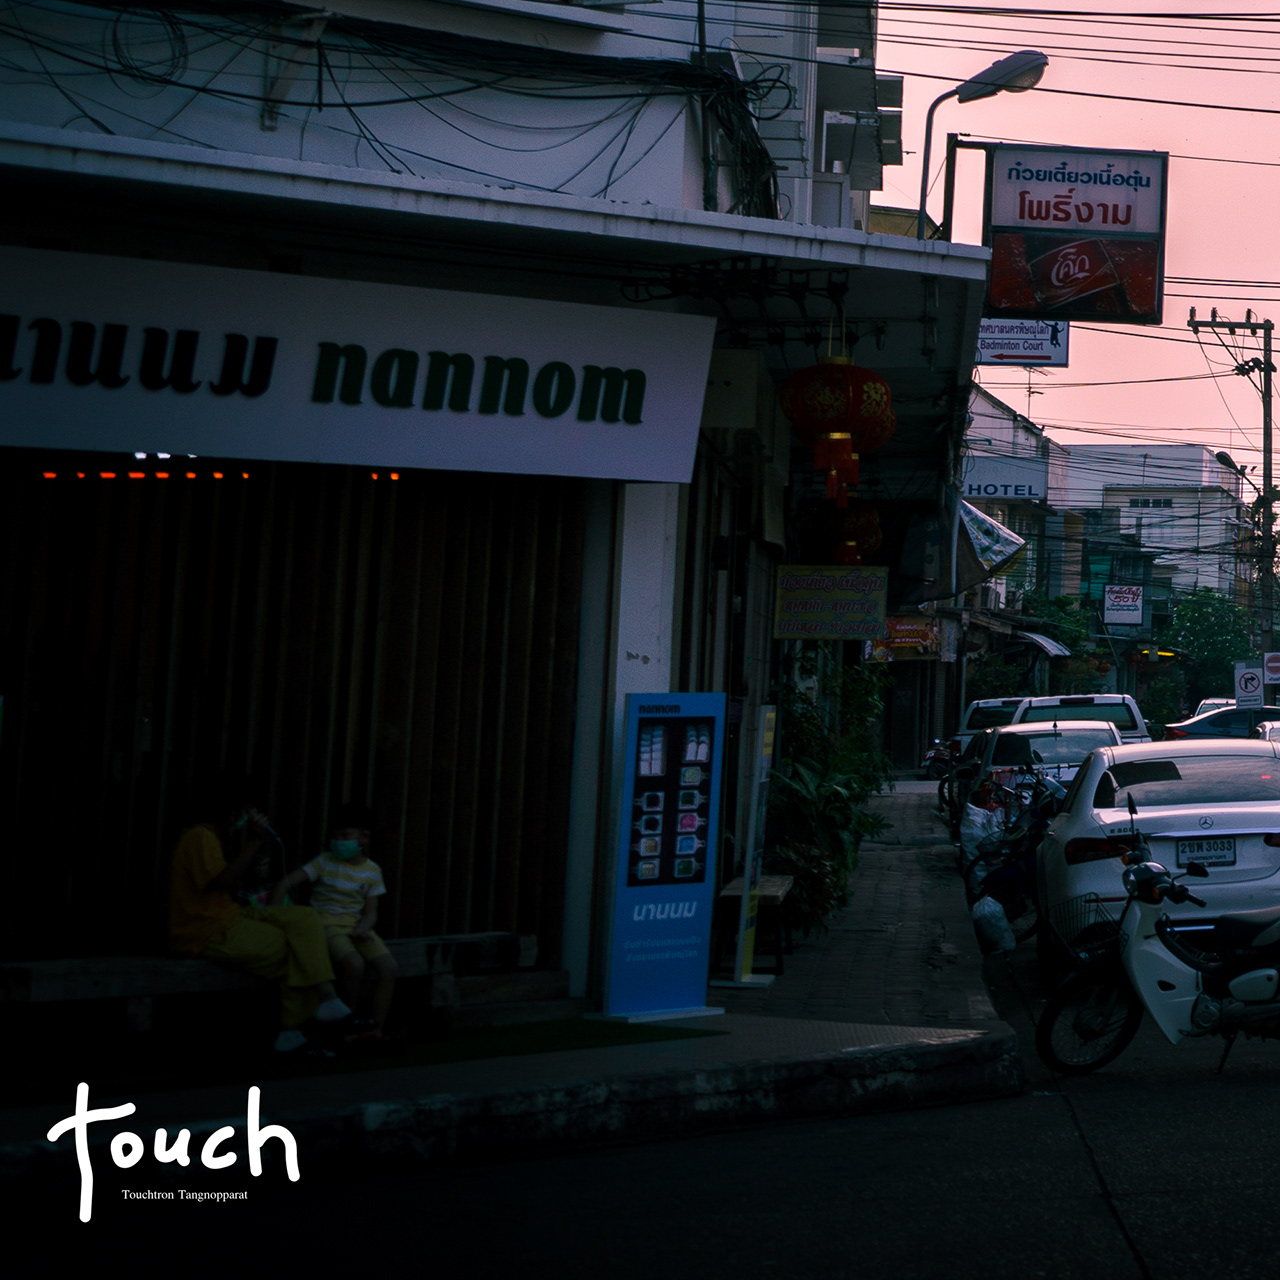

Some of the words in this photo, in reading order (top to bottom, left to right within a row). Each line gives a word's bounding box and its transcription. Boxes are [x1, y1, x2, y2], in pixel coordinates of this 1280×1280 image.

[1007, 161, 1151, 193] ก๋วยเตี๋ยวเนื้อตุ๋น
[1018, 188, 1133, 226] โพธิ์งาม
[979, 320, 1049, 338] ทศบาลนครพิษณุโลก
[980, 340, 1020, 351] Badminton
[1022, 340, 1044, 351] Court
[311, 340, 649, 425] nannom
[967, 483, 1040, 496] HOTEL
[638, 704, 681, 714] nannom
[1205, 839, 1233, 853] 3033
[632, 900, 697, 921] นานนม
